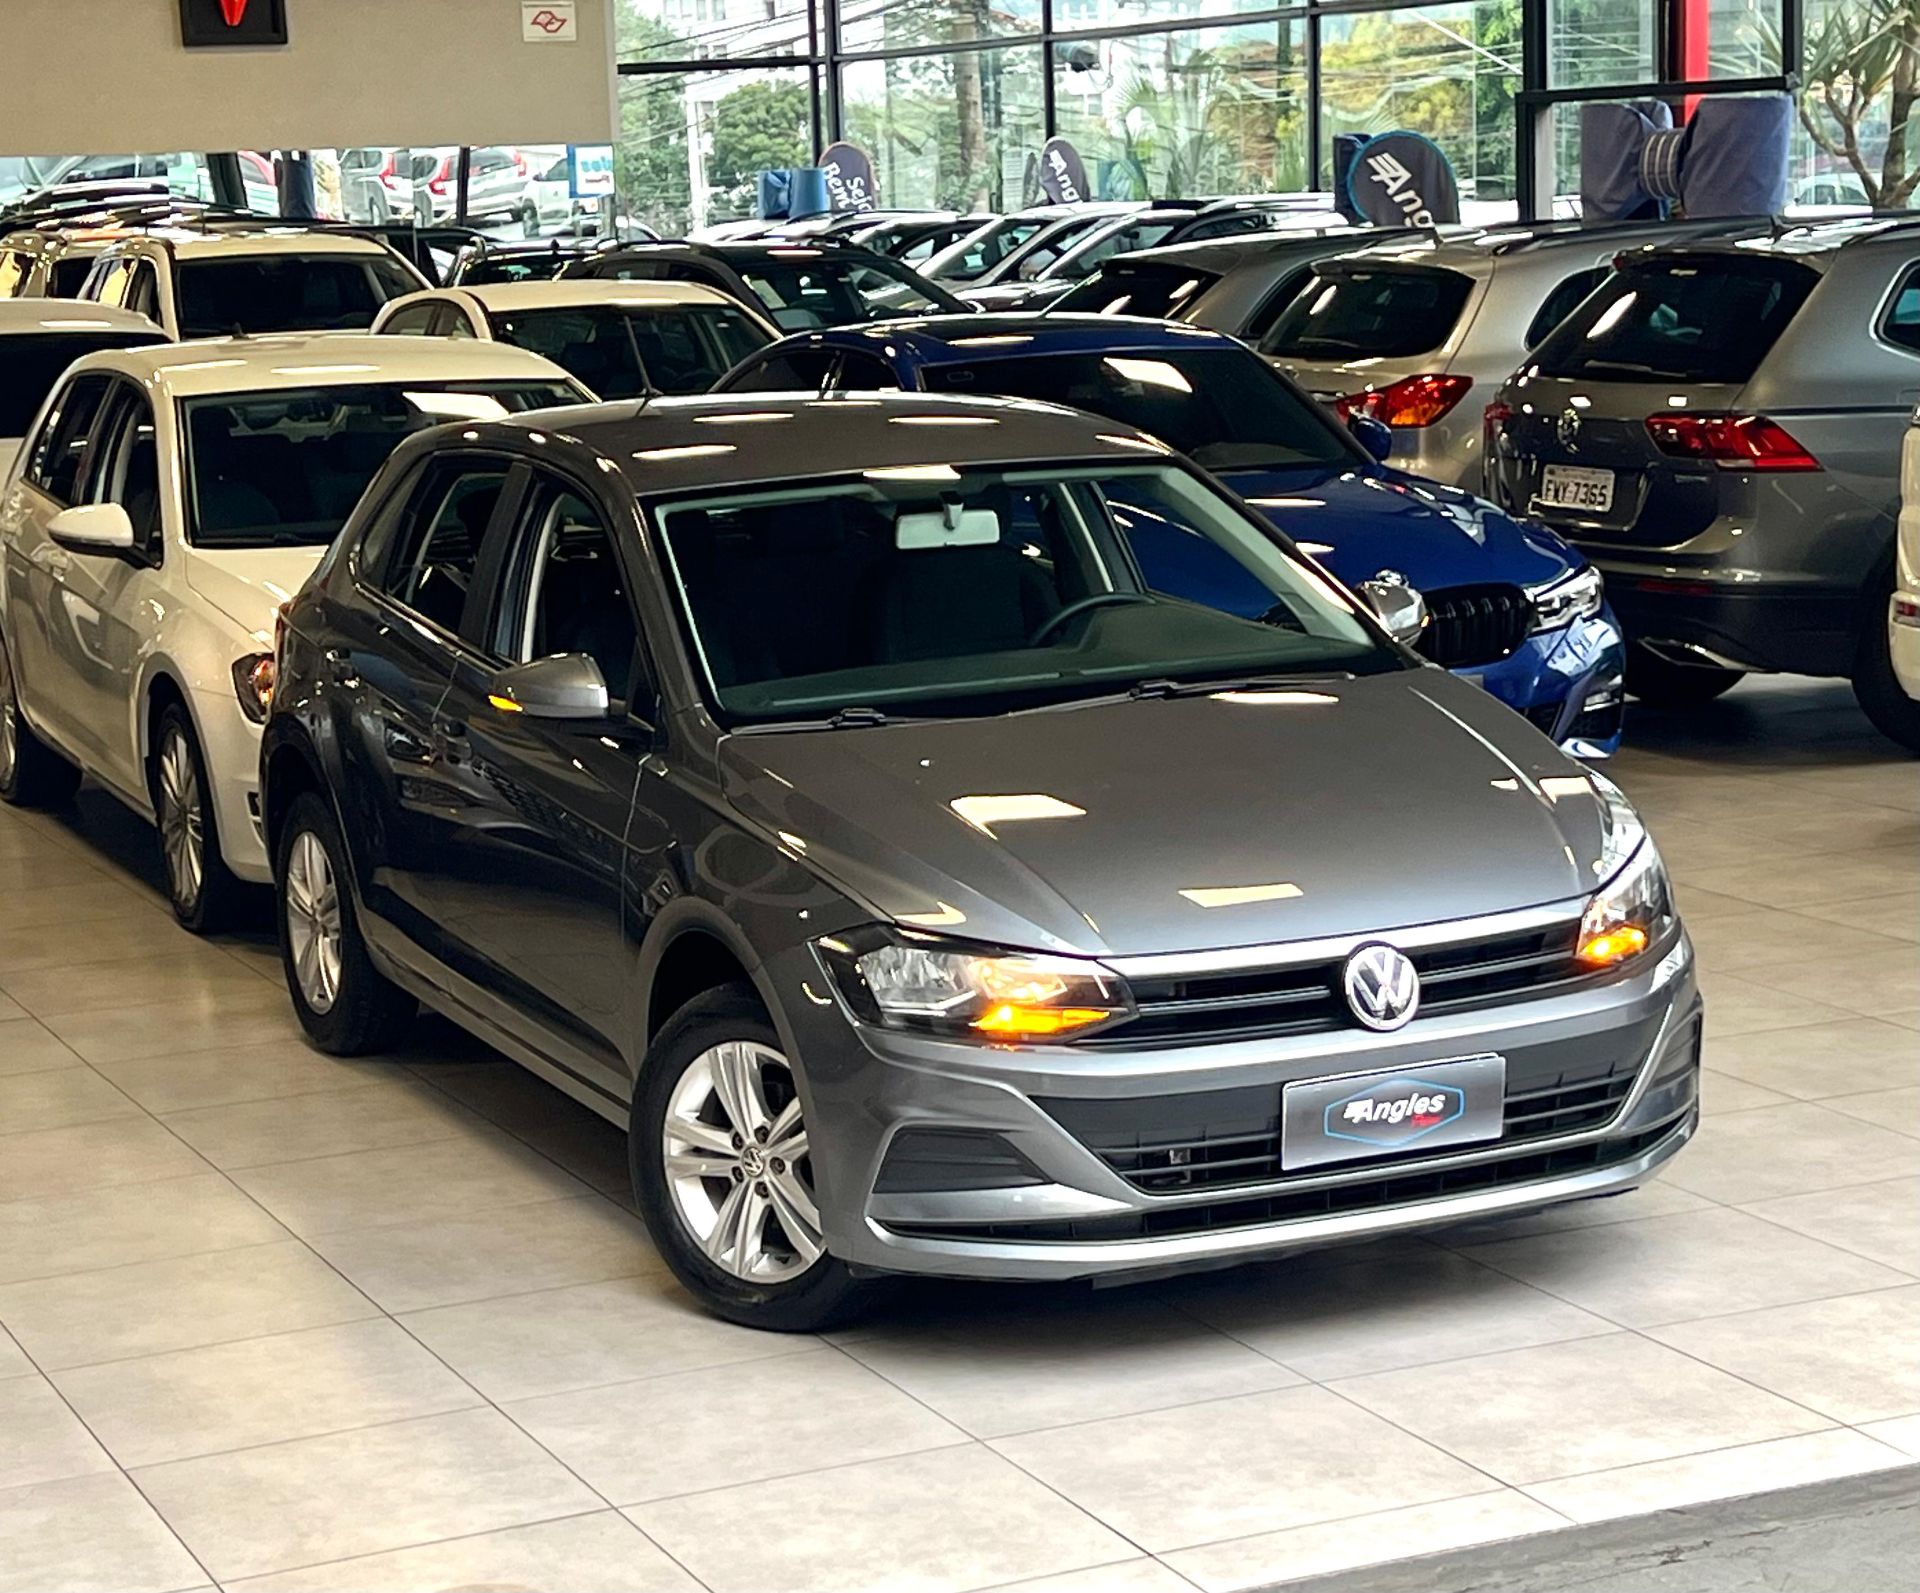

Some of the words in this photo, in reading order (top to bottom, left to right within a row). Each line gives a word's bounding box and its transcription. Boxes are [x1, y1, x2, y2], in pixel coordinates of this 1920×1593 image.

[823, 162, 850, 209] Bem
[1345, 945, 1420, 1031] VW
[1343, 1092, 1446, 1124] Angles
